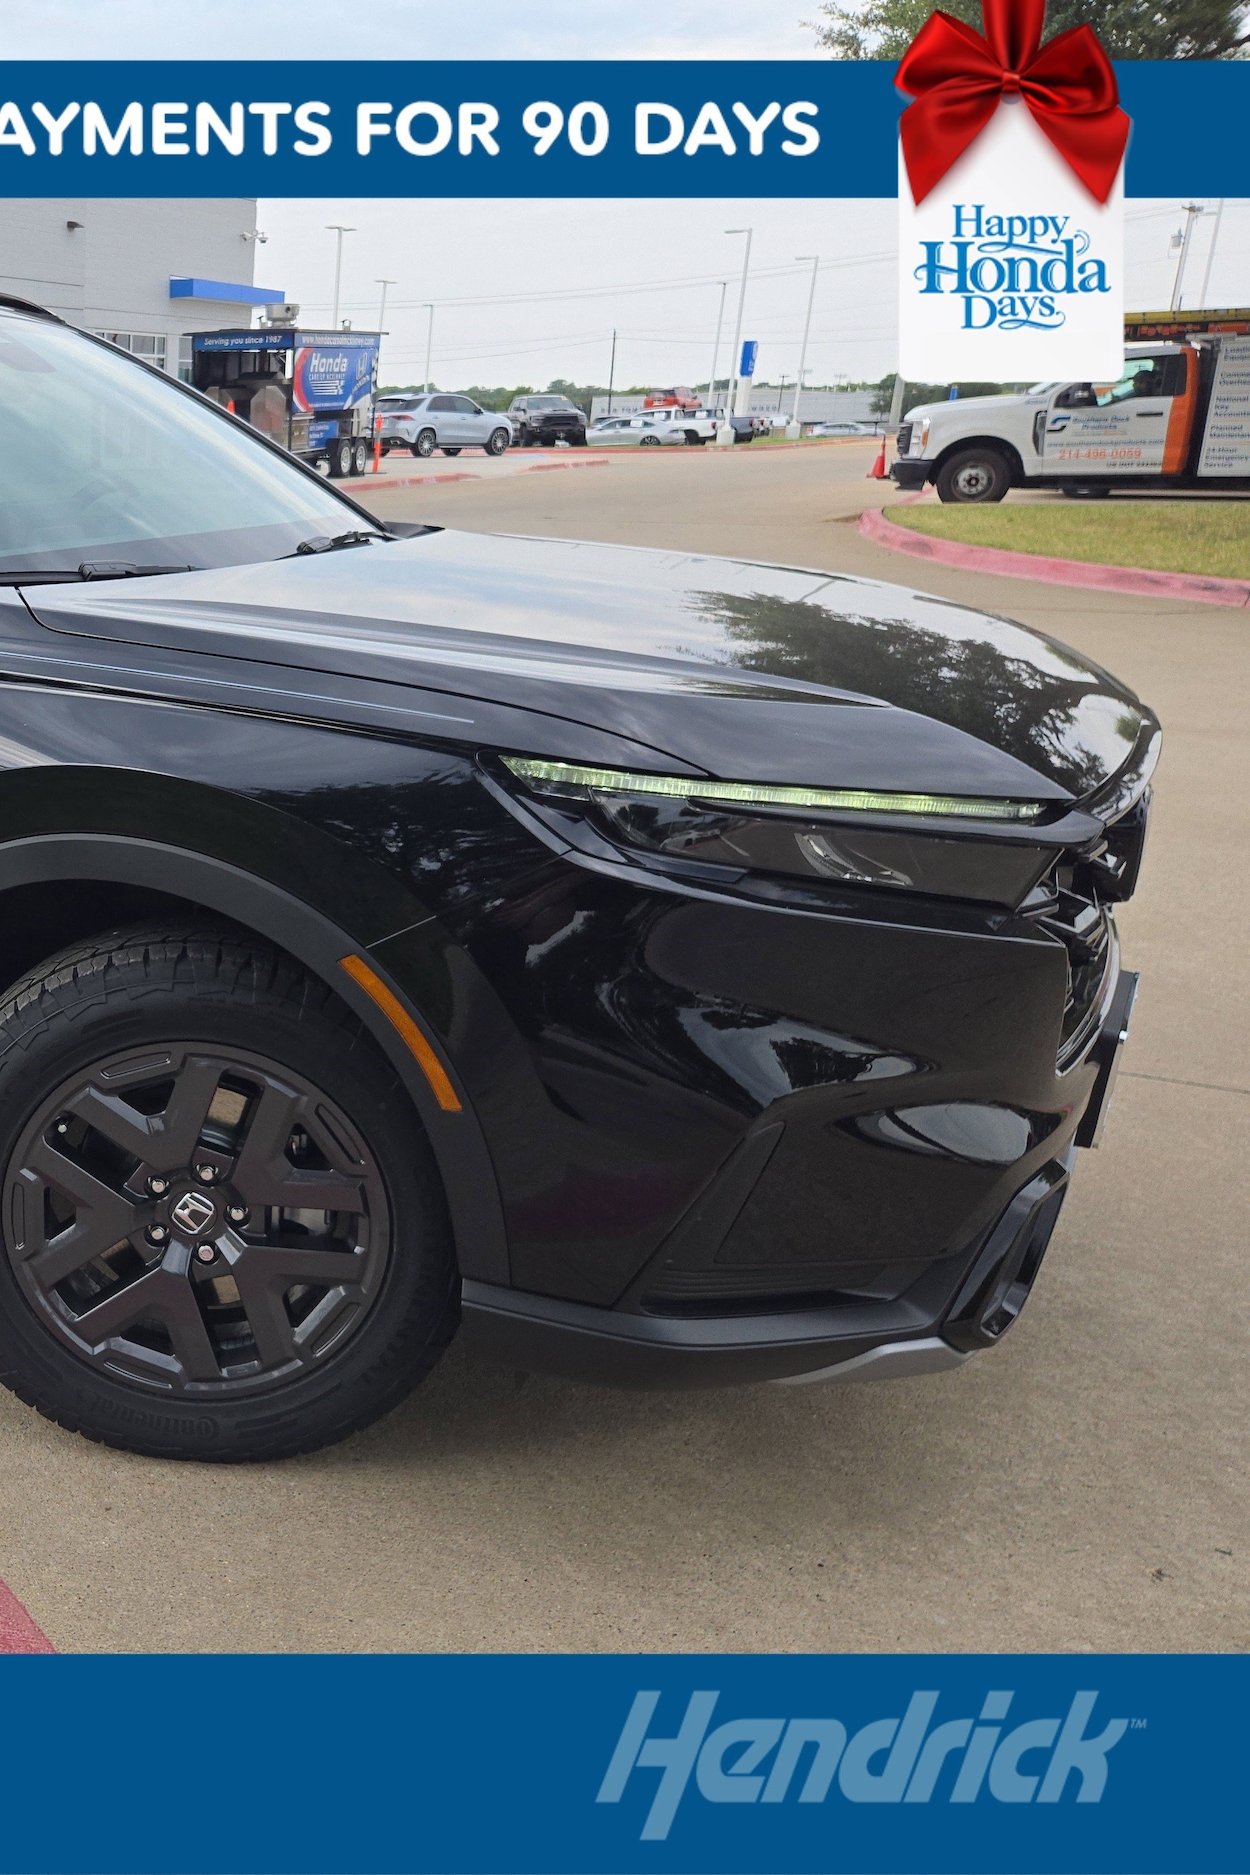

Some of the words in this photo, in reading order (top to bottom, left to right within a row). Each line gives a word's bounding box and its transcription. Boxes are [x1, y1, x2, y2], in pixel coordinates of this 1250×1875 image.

[204, 337, 229, 346] Serving
[230, 338, 243, 346] you
[245, 336, 263, 344] since
[265, 335, 283, 343] 1987
[310, 352, 348, 373] Honda
[1058, 447, 1142, 460] 214-496-0059
